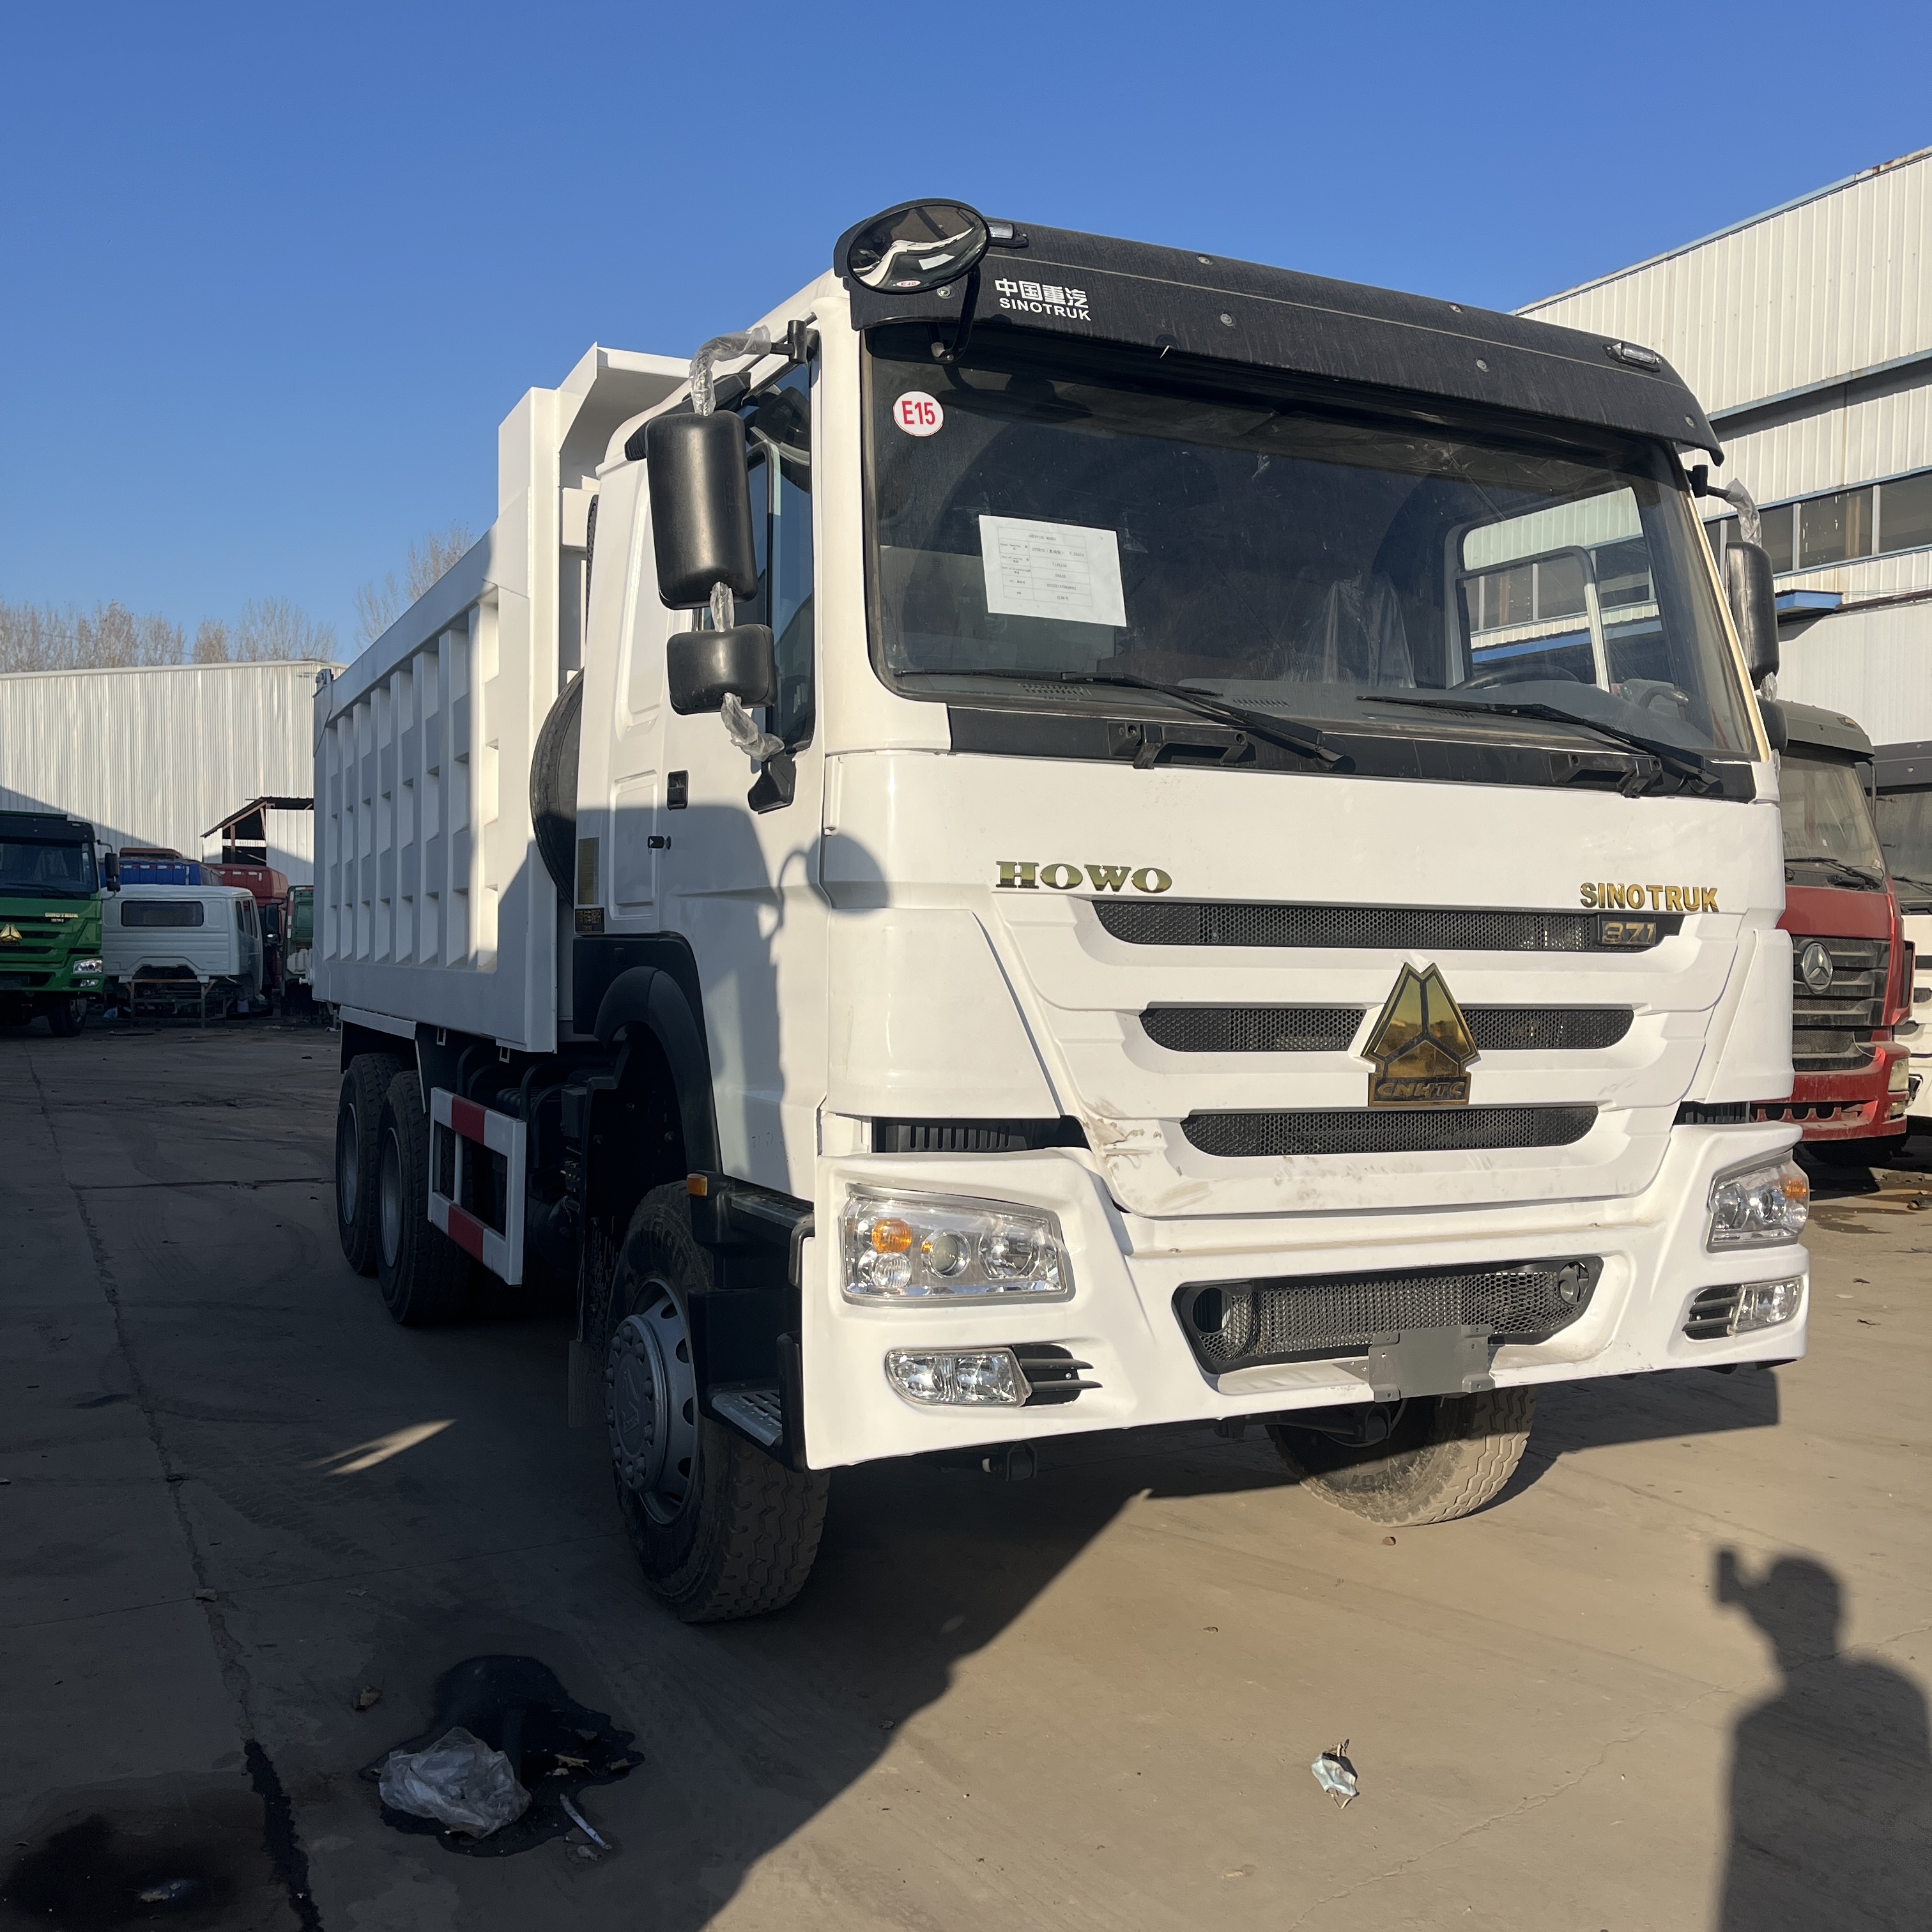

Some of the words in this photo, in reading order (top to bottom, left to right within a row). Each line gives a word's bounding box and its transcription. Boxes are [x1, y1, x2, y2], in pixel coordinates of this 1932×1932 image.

[994, 278, 1089, 309] 中国重汽
[999, 298, 1091, 321] SINOTRUK
[901, 401, 935, 425] E15
[995, 861, 1172, 894] HOWO
[1580, 882, 1720, 913] SINOTRUK
[1602, 922, 1656, 945] 371
[1377, 1081, 1465, 1098] CNHTC
